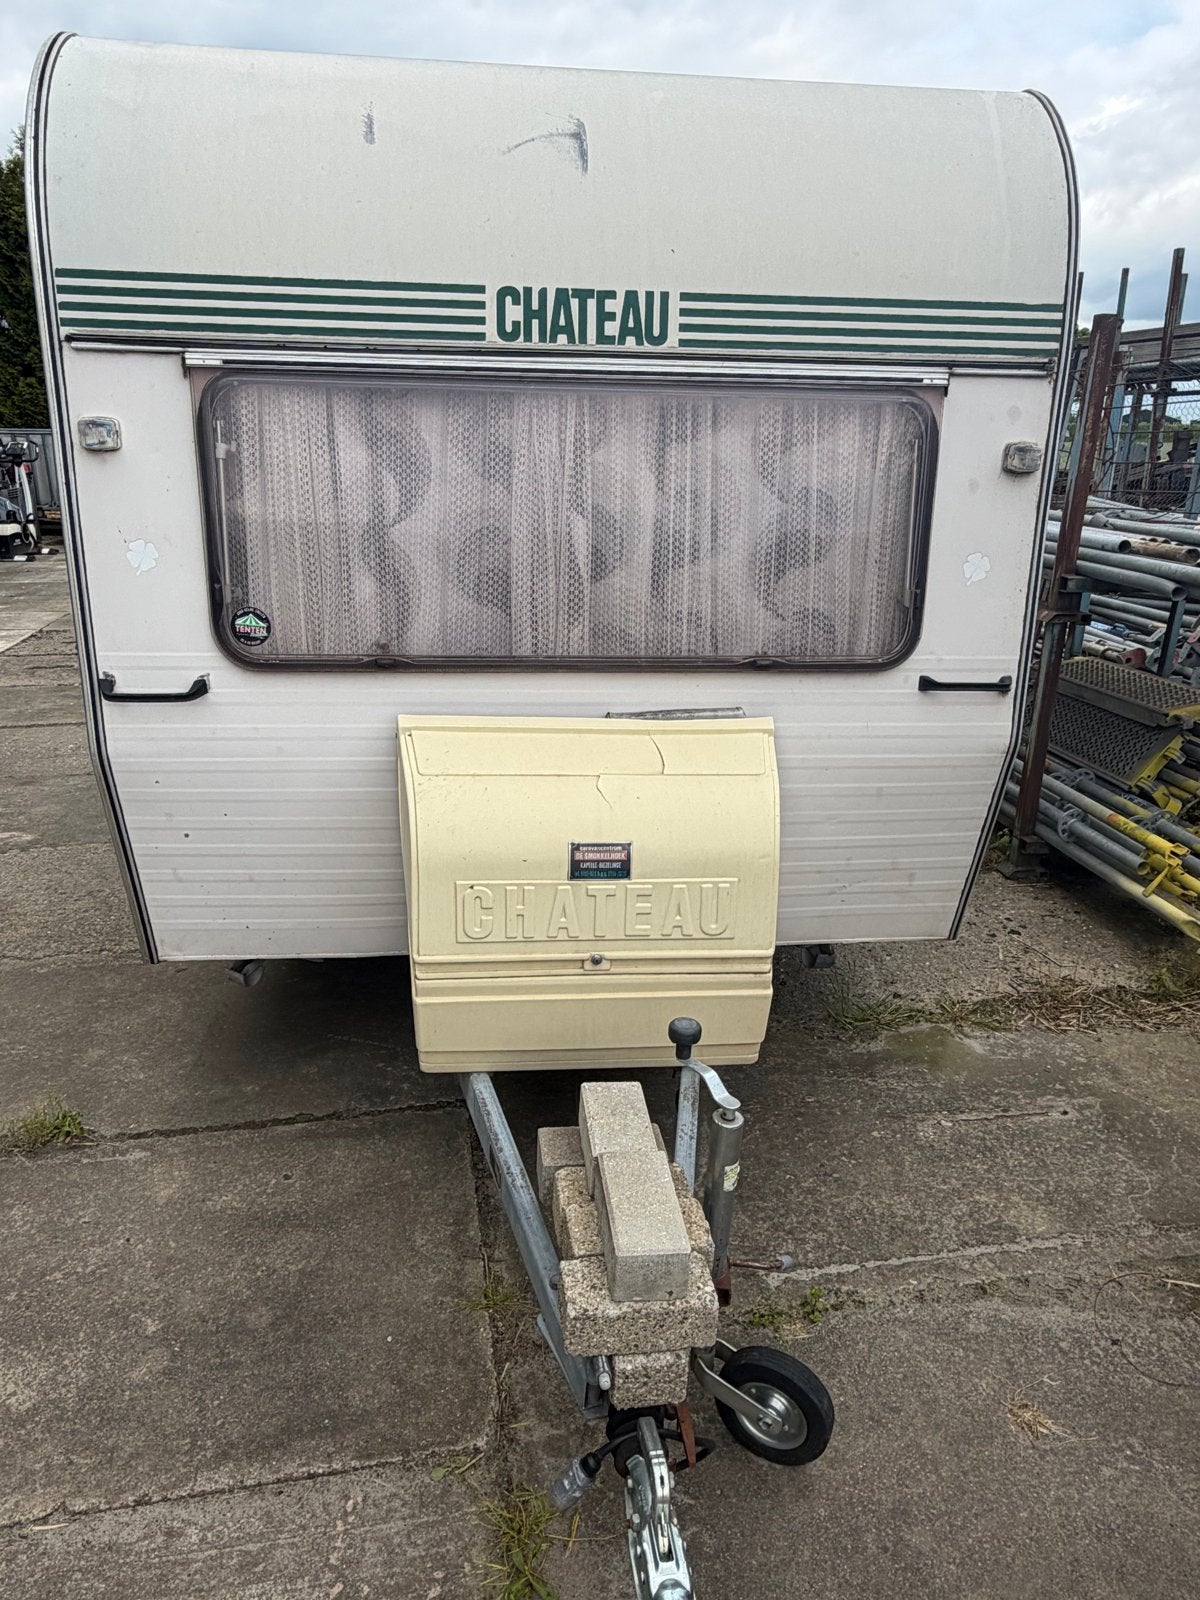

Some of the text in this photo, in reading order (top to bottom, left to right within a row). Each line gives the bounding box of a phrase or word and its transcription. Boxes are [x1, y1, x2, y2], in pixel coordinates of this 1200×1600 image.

[496, 285, 669, 347] CHATEAU
[235, 625, 267, 635] TENTEN
[463, 884, 730, 939] CHATEAU
